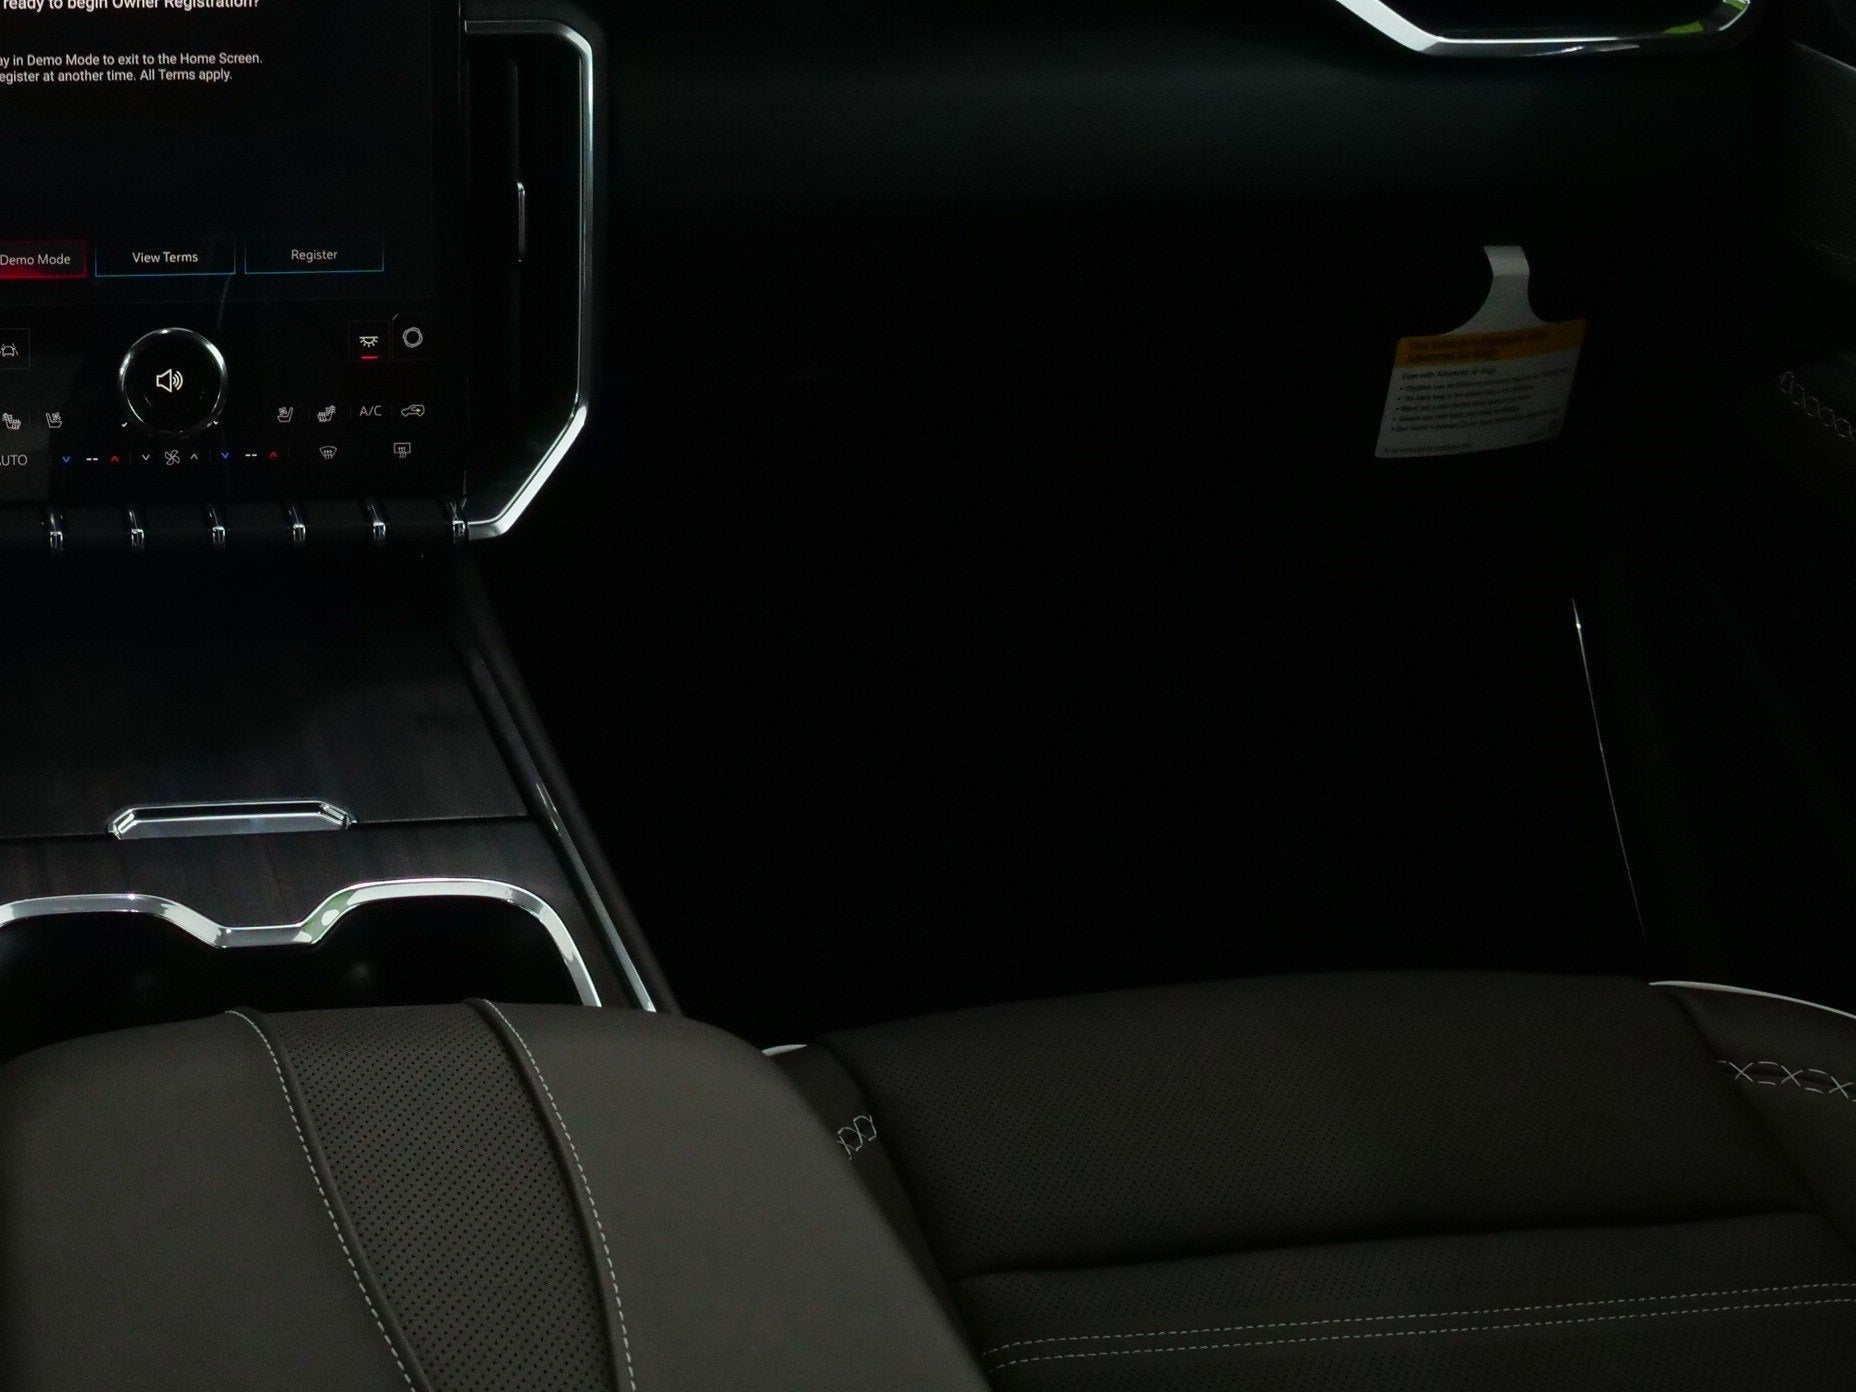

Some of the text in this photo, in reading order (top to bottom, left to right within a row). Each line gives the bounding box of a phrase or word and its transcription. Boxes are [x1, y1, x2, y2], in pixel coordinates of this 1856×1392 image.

[12, 54, 24, 67] in
[27, 53, 63, 67] Demo
[65, 53, 100, 66] Mode
[102, 54, 115, 66] to
[117, 53, 140, 66] exit
[142, 54, 155, 65] to
[157, 52, 178, 65] the
[180, 52, 216, 65] Home
[218, 52, 263, 66] Screen.
[42, 70, 55, 82] at
[57, 69, 104, 82] another
[106, 69, 136, 82] time.
[139, 68, 155, 81] All
[158, 68, 196, 81] Terms
[198, 67, 233, 83] apply.
[0, 254, 35, 266] Demo
[37, 253, 71, 266] Mode
[132, 251, 199, 264] View Terms
[291, 248, 338, 264] Register
[359, 404, 382, 417] A/C
